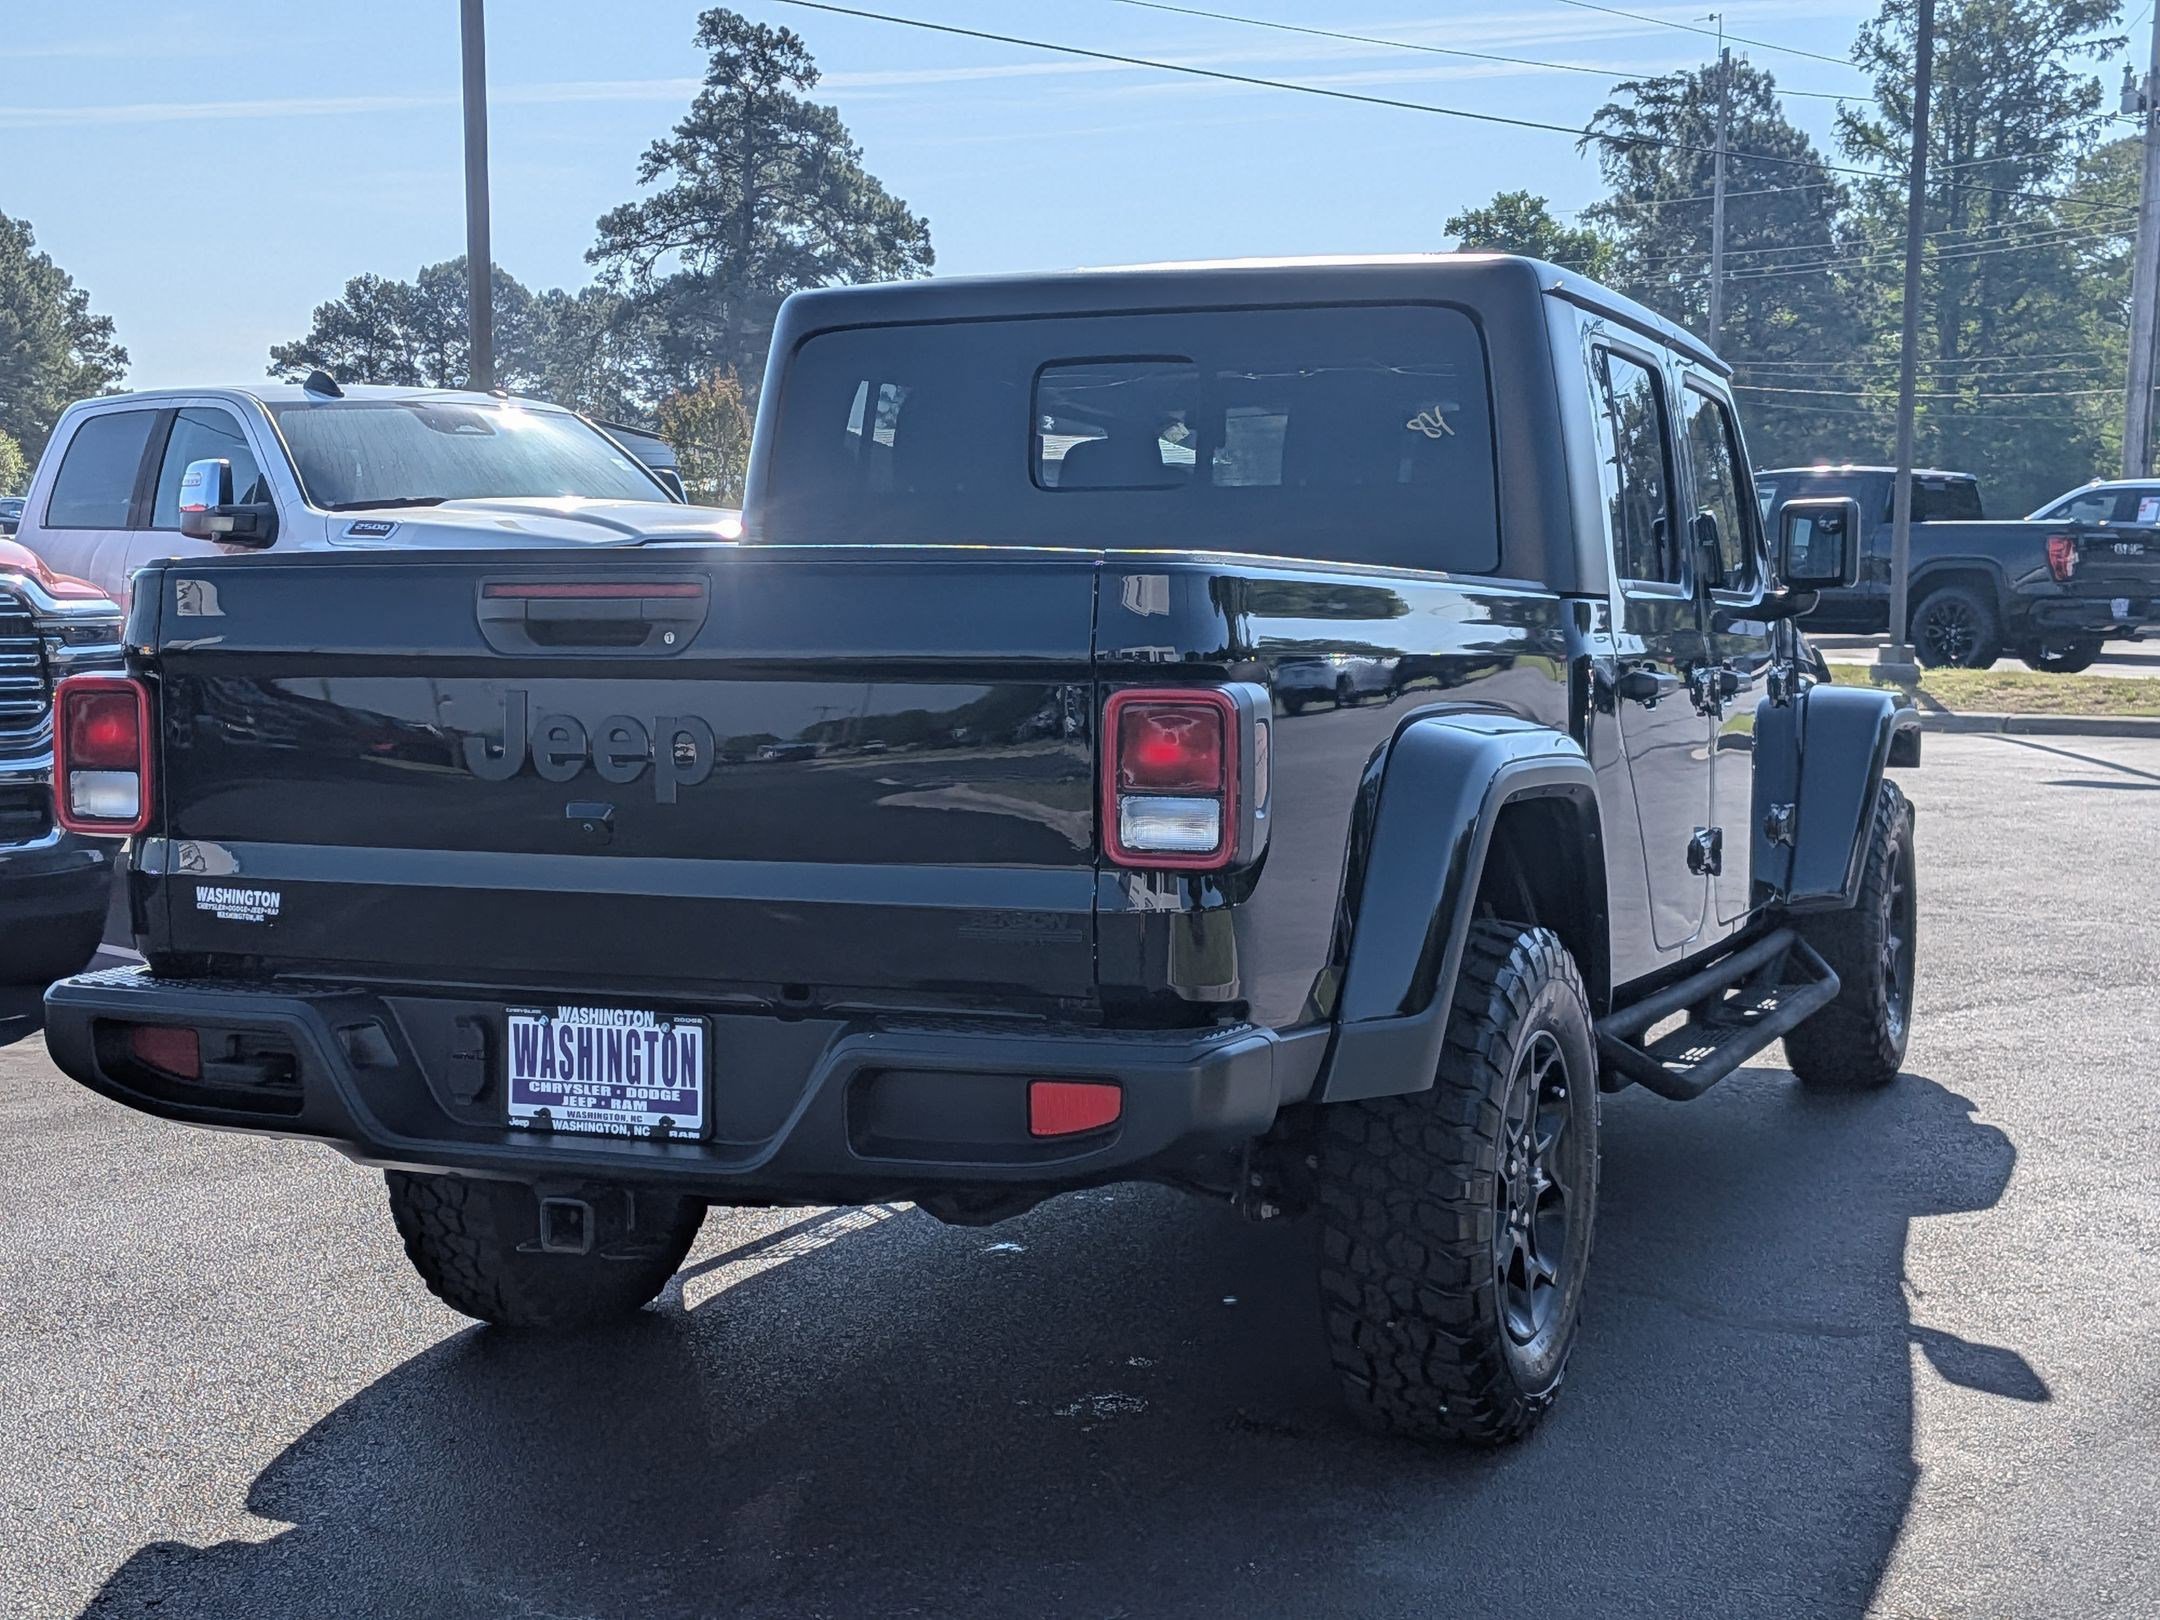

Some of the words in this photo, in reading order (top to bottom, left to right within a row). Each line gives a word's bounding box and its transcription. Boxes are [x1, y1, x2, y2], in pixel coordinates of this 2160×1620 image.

[355, 523, 391, 531] 2500
[462, 690, 716, 804] Jeep
[196, 886, 280, 908] WASHINGTON
[557, 1005, 655, 1028] WASHINGTON
[512, 1022, 697, 1089] WASHINGTON
[529, 1081, 612, 1097] CHRYSLER
[626, 1087, 681, 1102] DODGE
[562, 1096, 597, 1107] JEEP
[610, 1099, 648, 1111] RAM
[508, 1117, 530, 1128] Jeep
[552, 1119, 631, 1137] WASHINGTON,
[634, 1125, 651, 1137] NC
[668, 1130, 700, 1139] RAM
